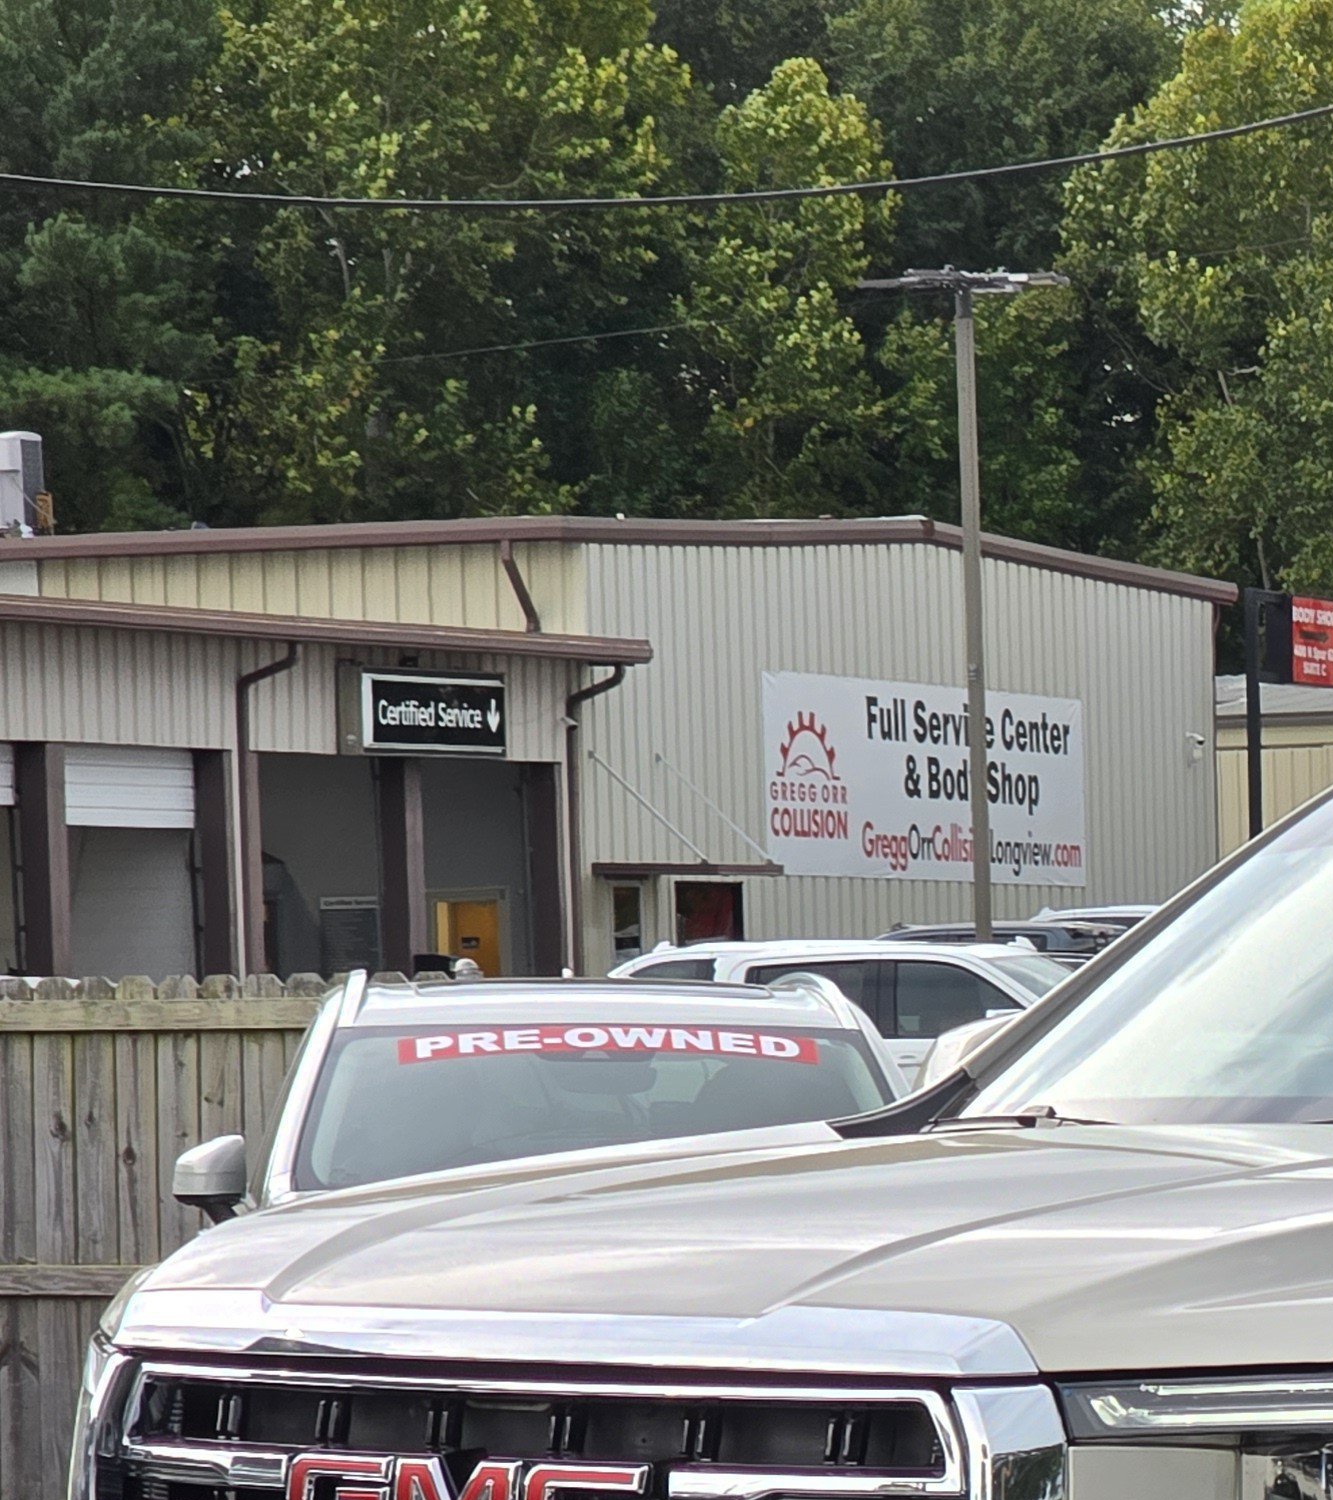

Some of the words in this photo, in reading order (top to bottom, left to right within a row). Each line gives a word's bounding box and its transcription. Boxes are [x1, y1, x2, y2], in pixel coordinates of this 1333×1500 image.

[379, 699, 435, 727] Certified
[438, 702, 482, 728] Service
[865, 695, 908, 743] Full
[912, 699, 995, 750] Servie
[1001, 708, 1070, 756] Center
[769, 781, 817, 803] GREGG
[821, 784, 848, 805] ORR
[904, 754, 922, 799] &
[927, 756, 970, 801] Bod
[986, 761, 1040, 816] Shop
[770, 807, 849, 840] COLLISION
[861, 821, 1083, 877] GreggOrrCollisiLongview.com
[414, 1027, 801, 1059] PRE-OWNED
